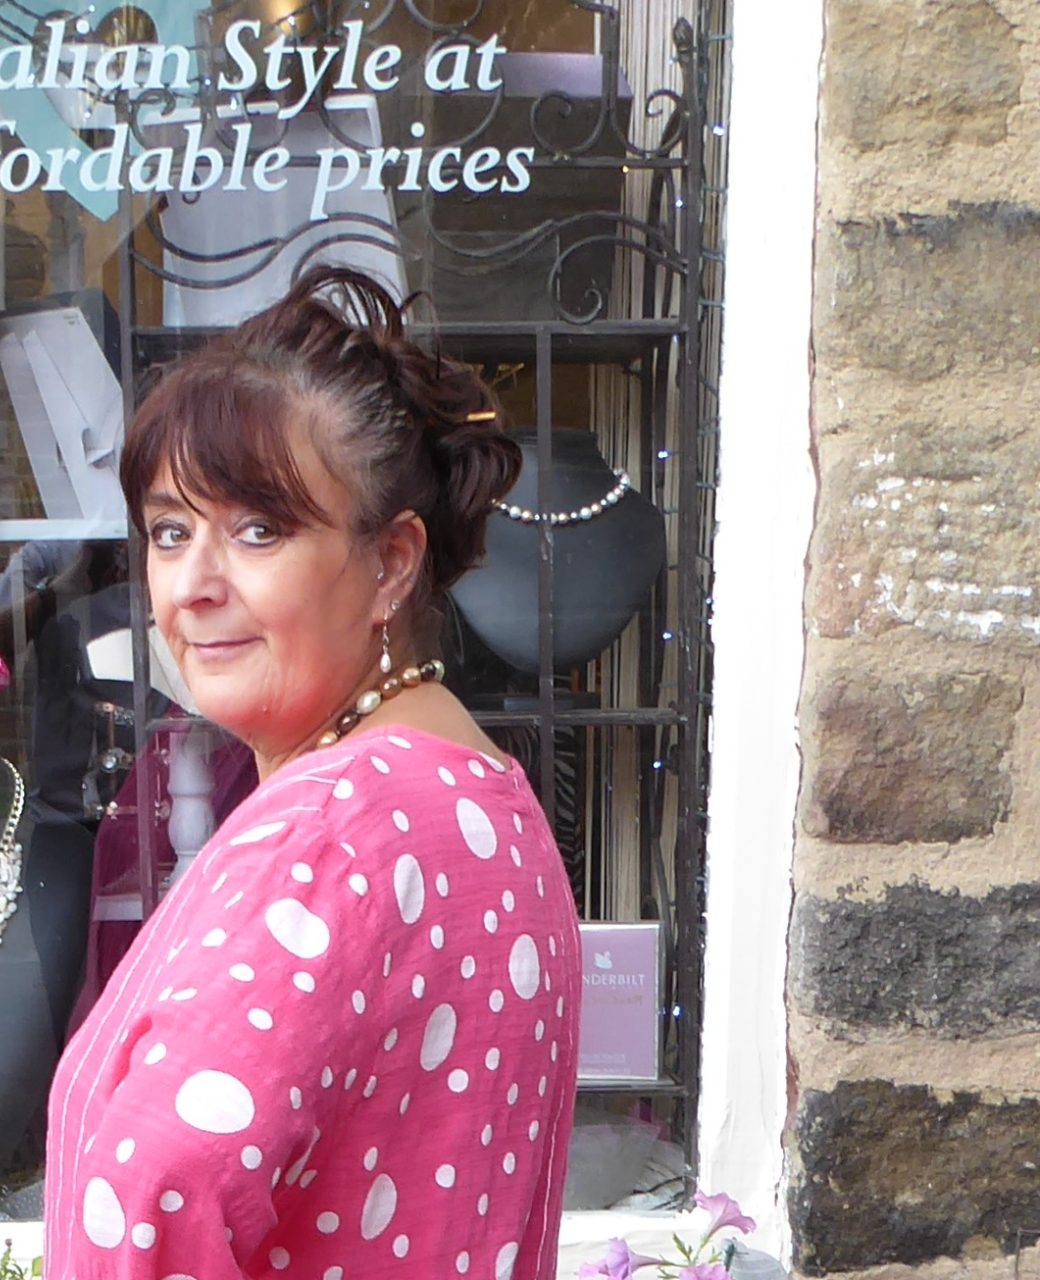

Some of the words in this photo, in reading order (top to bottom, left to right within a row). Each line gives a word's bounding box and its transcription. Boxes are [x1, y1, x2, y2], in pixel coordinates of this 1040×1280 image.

[217, 19, 402, 120] Style
[424, 33, 508, 91] at
[310, 121, 535, 220] prices
